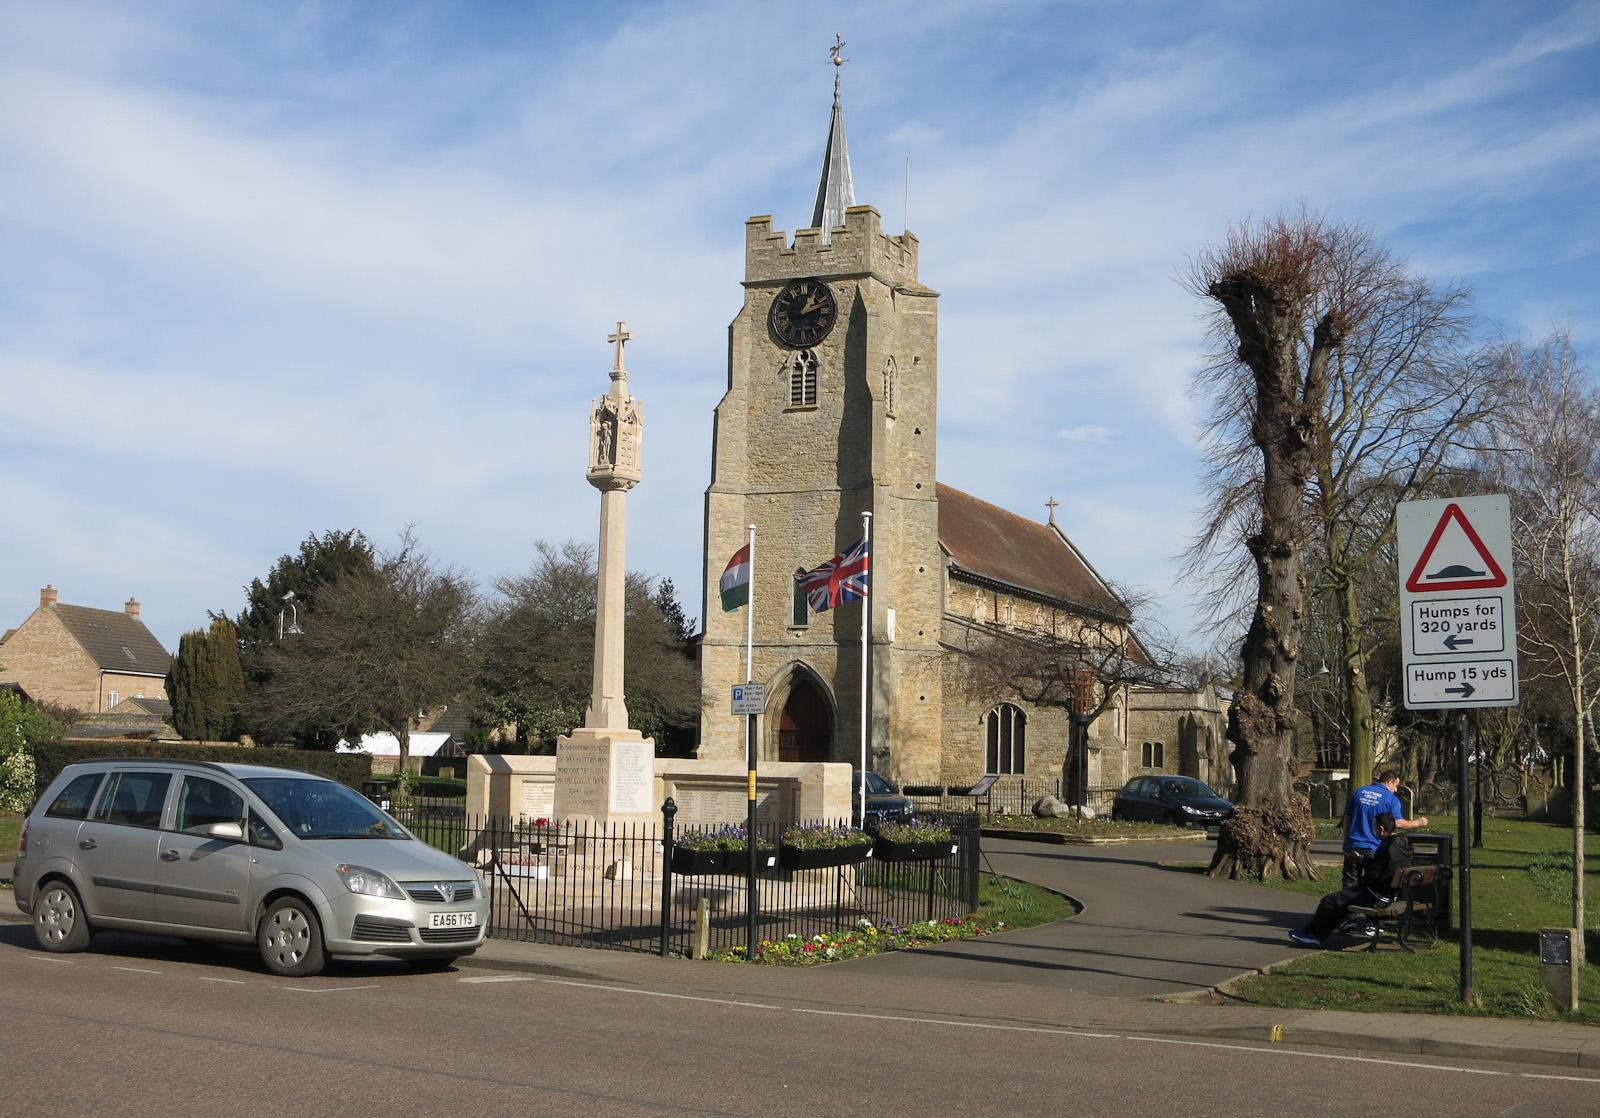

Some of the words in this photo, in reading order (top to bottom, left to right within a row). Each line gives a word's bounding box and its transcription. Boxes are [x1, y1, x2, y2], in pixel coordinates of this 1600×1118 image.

[1419, 606, 1470, 619] Humps
[1475, 604, 1496, 616] for
[1420, 621, 1450, 633] 320
[1455, 619, 1497, 633] yards
[1414, 669, 1456, 682] Hump
[1461, 667, 1477, 679] 15
[1482, 666, 1507, 681] yds
[433, 914, 457, 926] EA56
[459, 913, 473, 926] TYS
